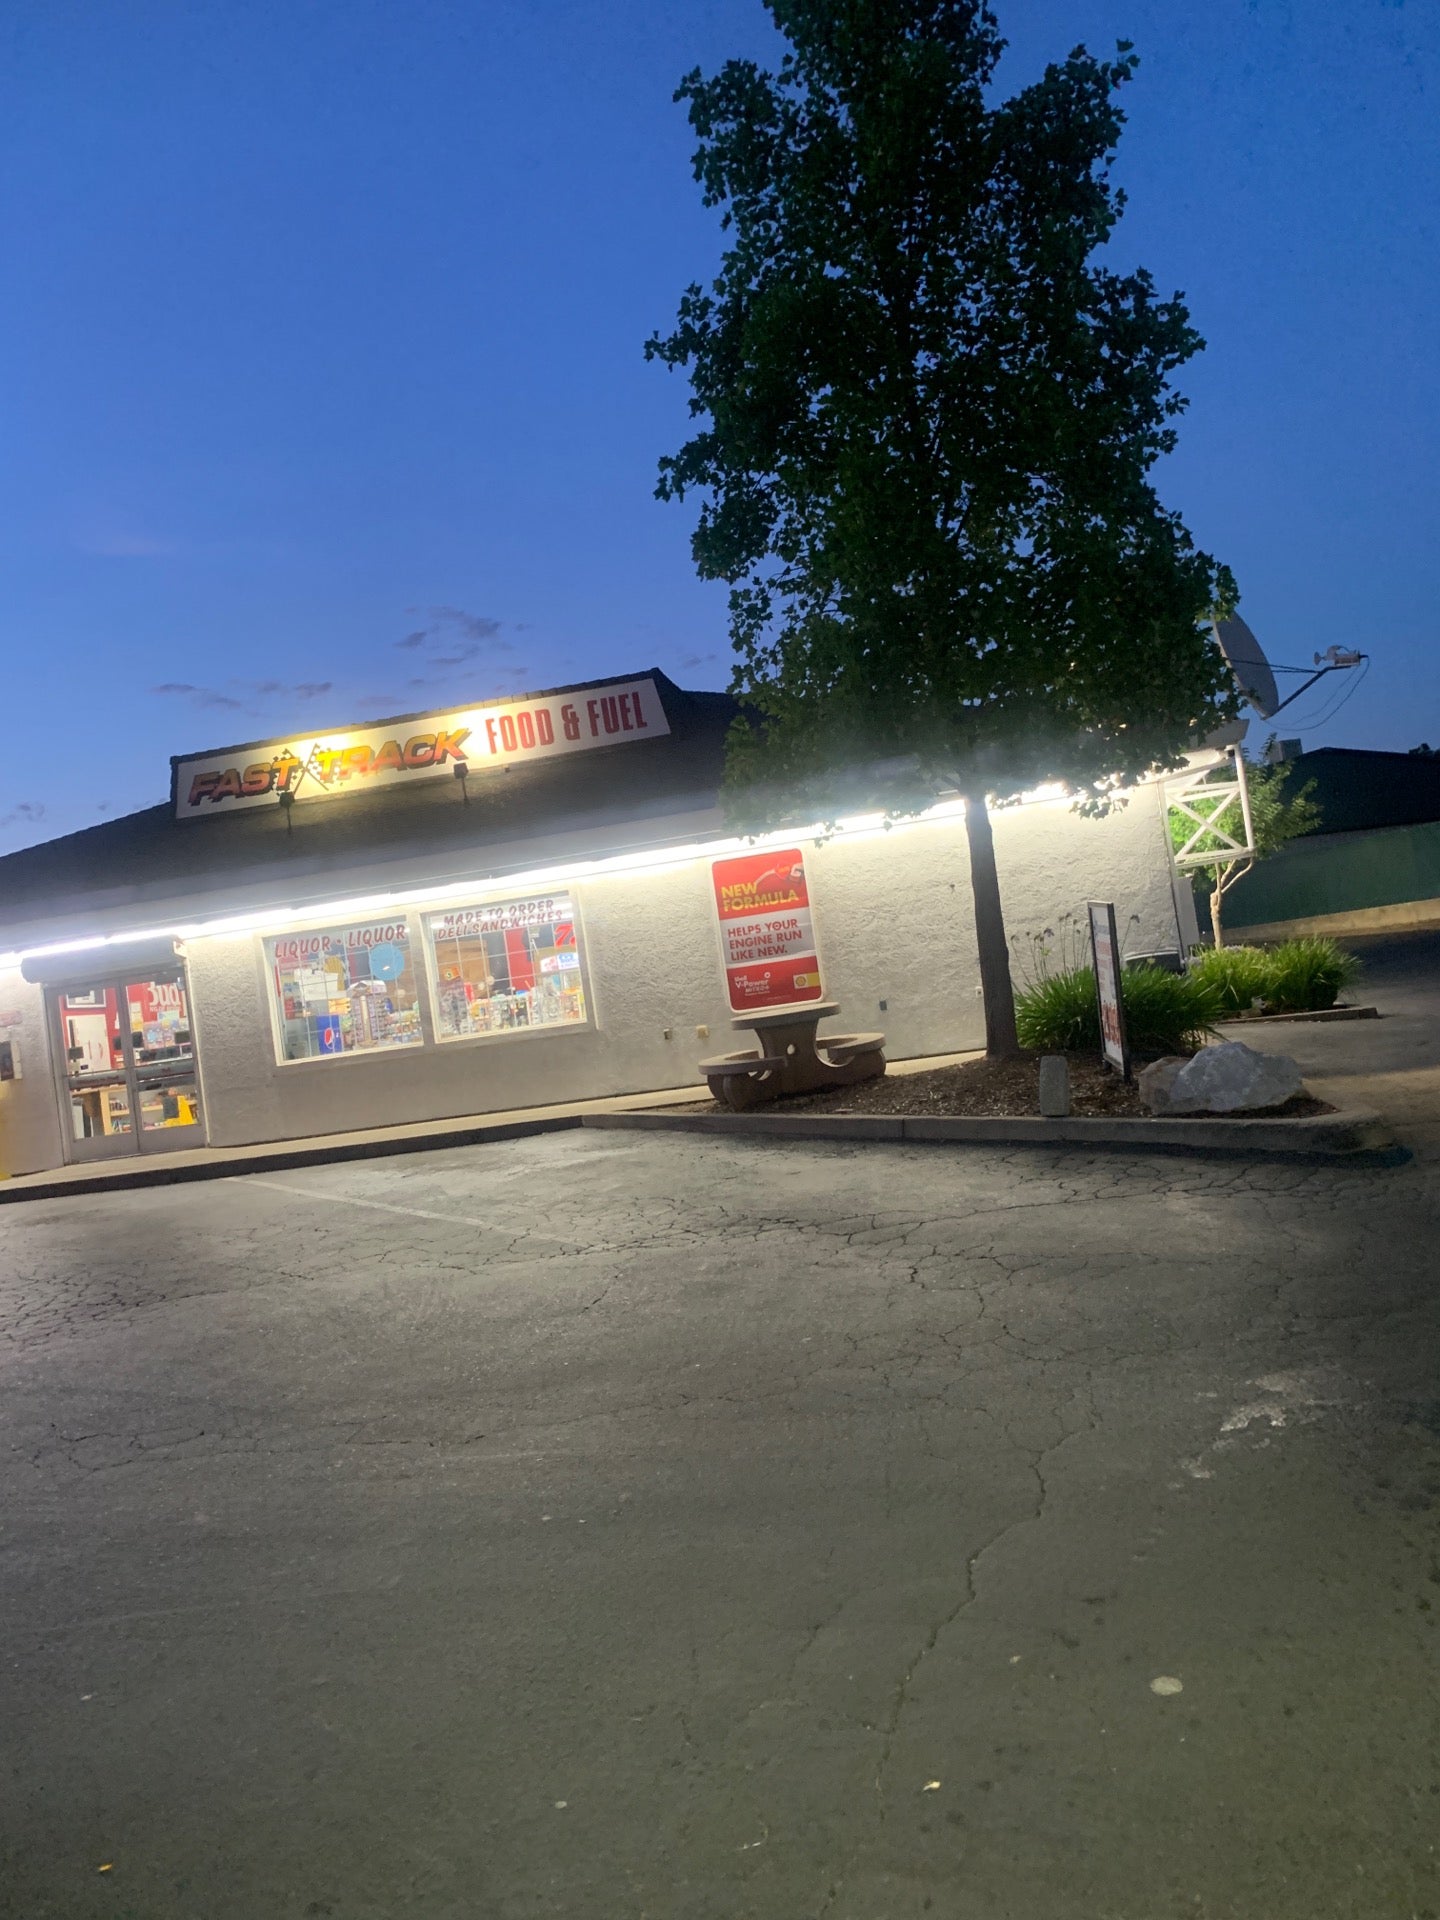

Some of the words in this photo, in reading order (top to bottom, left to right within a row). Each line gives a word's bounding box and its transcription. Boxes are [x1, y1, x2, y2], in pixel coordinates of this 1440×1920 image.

[485, 708, 555, 754] FOOD
[561, 704, 580, 741] &
[587, 691, 648, 737] FUEL
[188, 756, 300, 806] FAST
[315, 728, 472, 783] TRACK
[721, 882, 758, 898] NEW
[723, 889, 799, 912] FORMULA
[443, 910, 484, 926] MADE
[487, 907, 504, 919] TO
[508, 899, 555, 915] ORDER
[437, 926, 468, 940] DELI
[471, 911, 563, 934] SANDWICHES
[728, 923, 761, 938] HELPS
[765, 918, 798, 932] YOUR
[274, 936, 331, 959] LIQUOR
[348, 923, 406, 949] LIQUOR
[729, 935, 773, 950] ENGINE
[776, 929, 803, 943] RUN
[730, 950, 754, 961] LIKE
[758, 944, 788, 957] NEW.
[735, 979, 769, 990] V-Power
